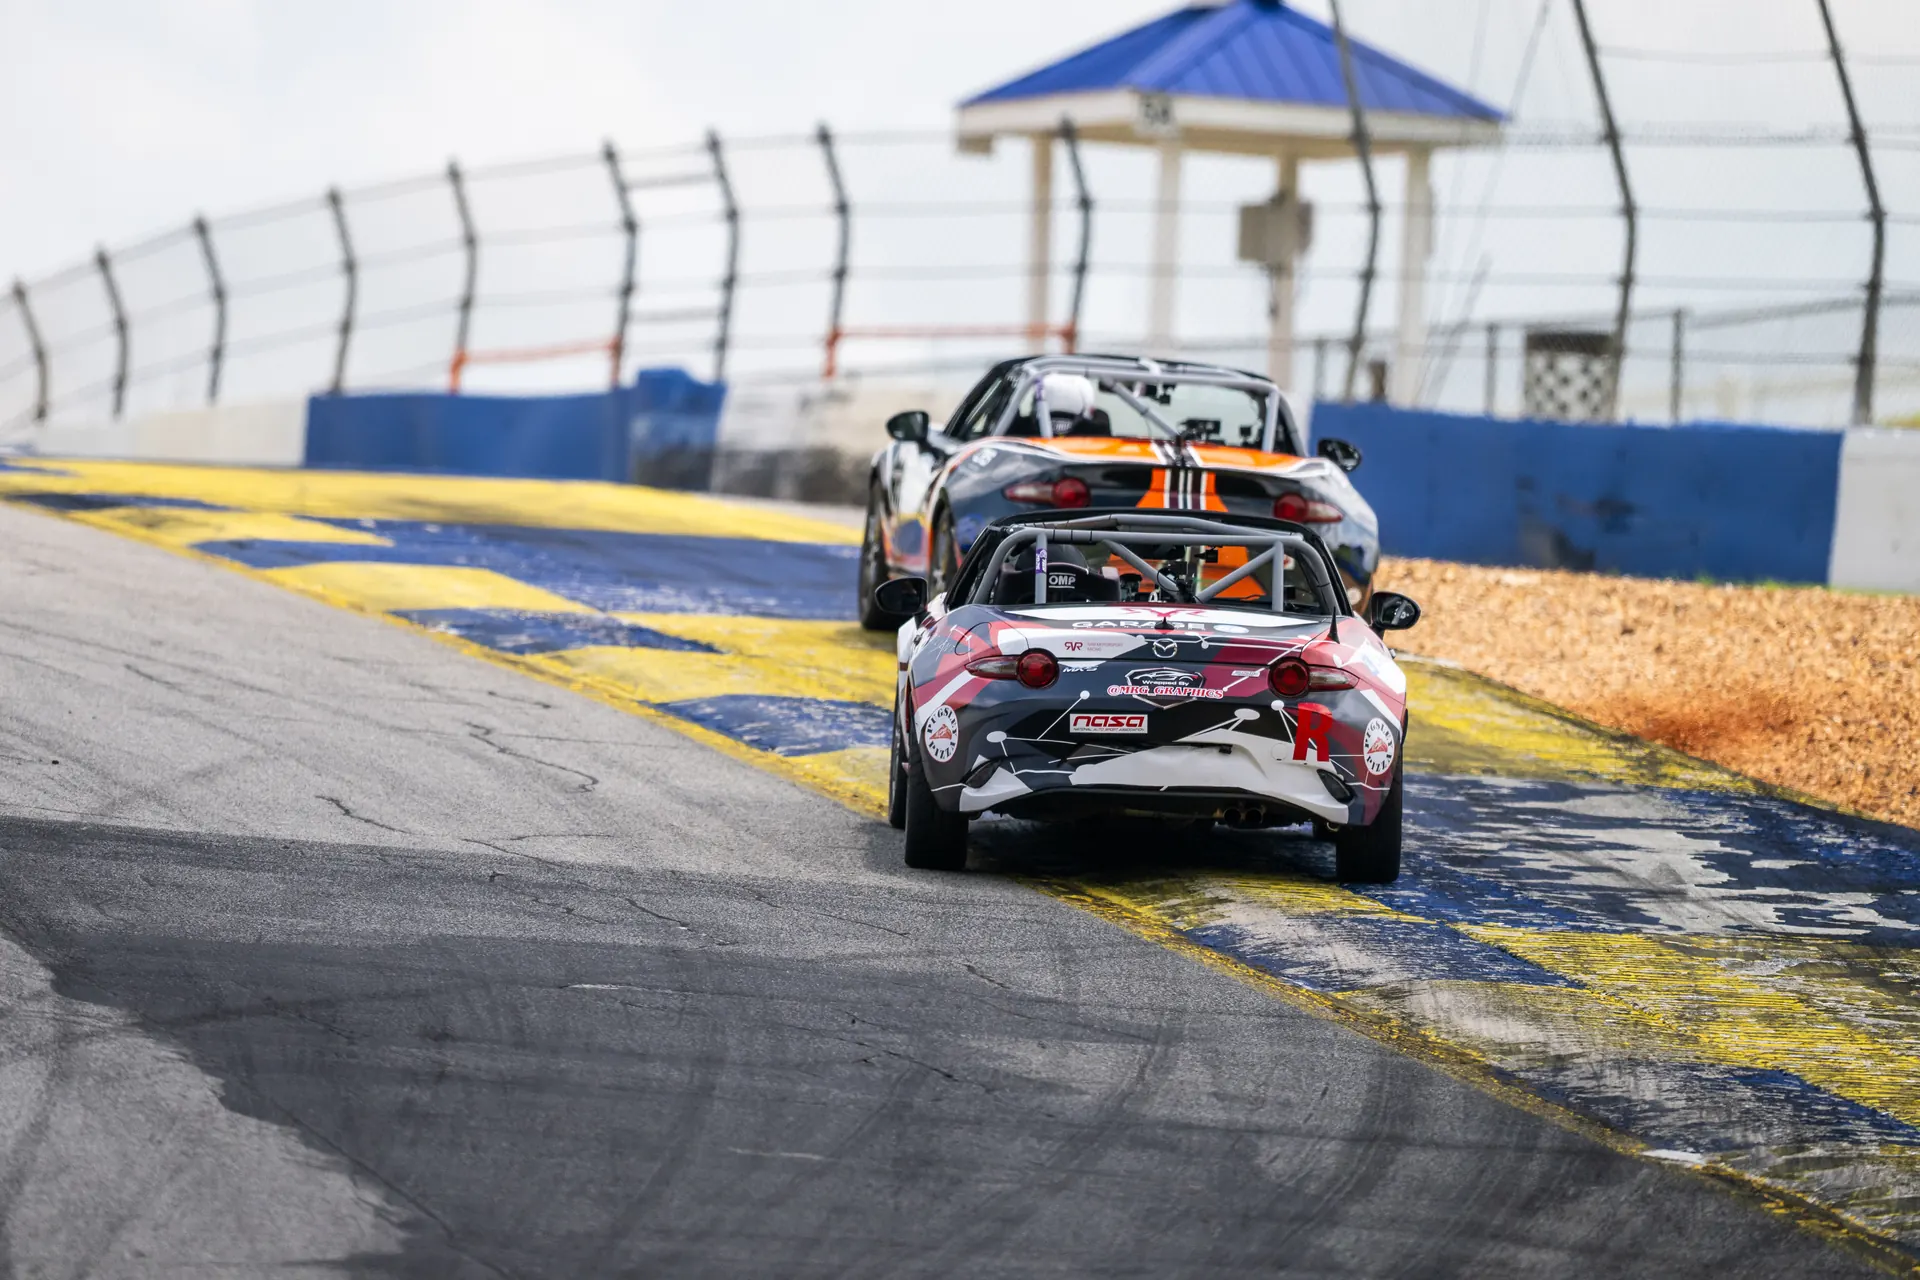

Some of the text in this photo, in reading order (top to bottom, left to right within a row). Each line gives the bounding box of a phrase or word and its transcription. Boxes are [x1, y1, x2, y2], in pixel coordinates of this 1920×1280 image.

[1049, 575, 1076, 586] OMP
[927, 707, 957, 736] PUGSLEY
[1293, 702, 1333, 762] R
[1365, 721, 1393, 748] PUGSLEY
[929, 741, 956, 759] PIZZA
[1366, 754, 1392, 772] PIZZA
